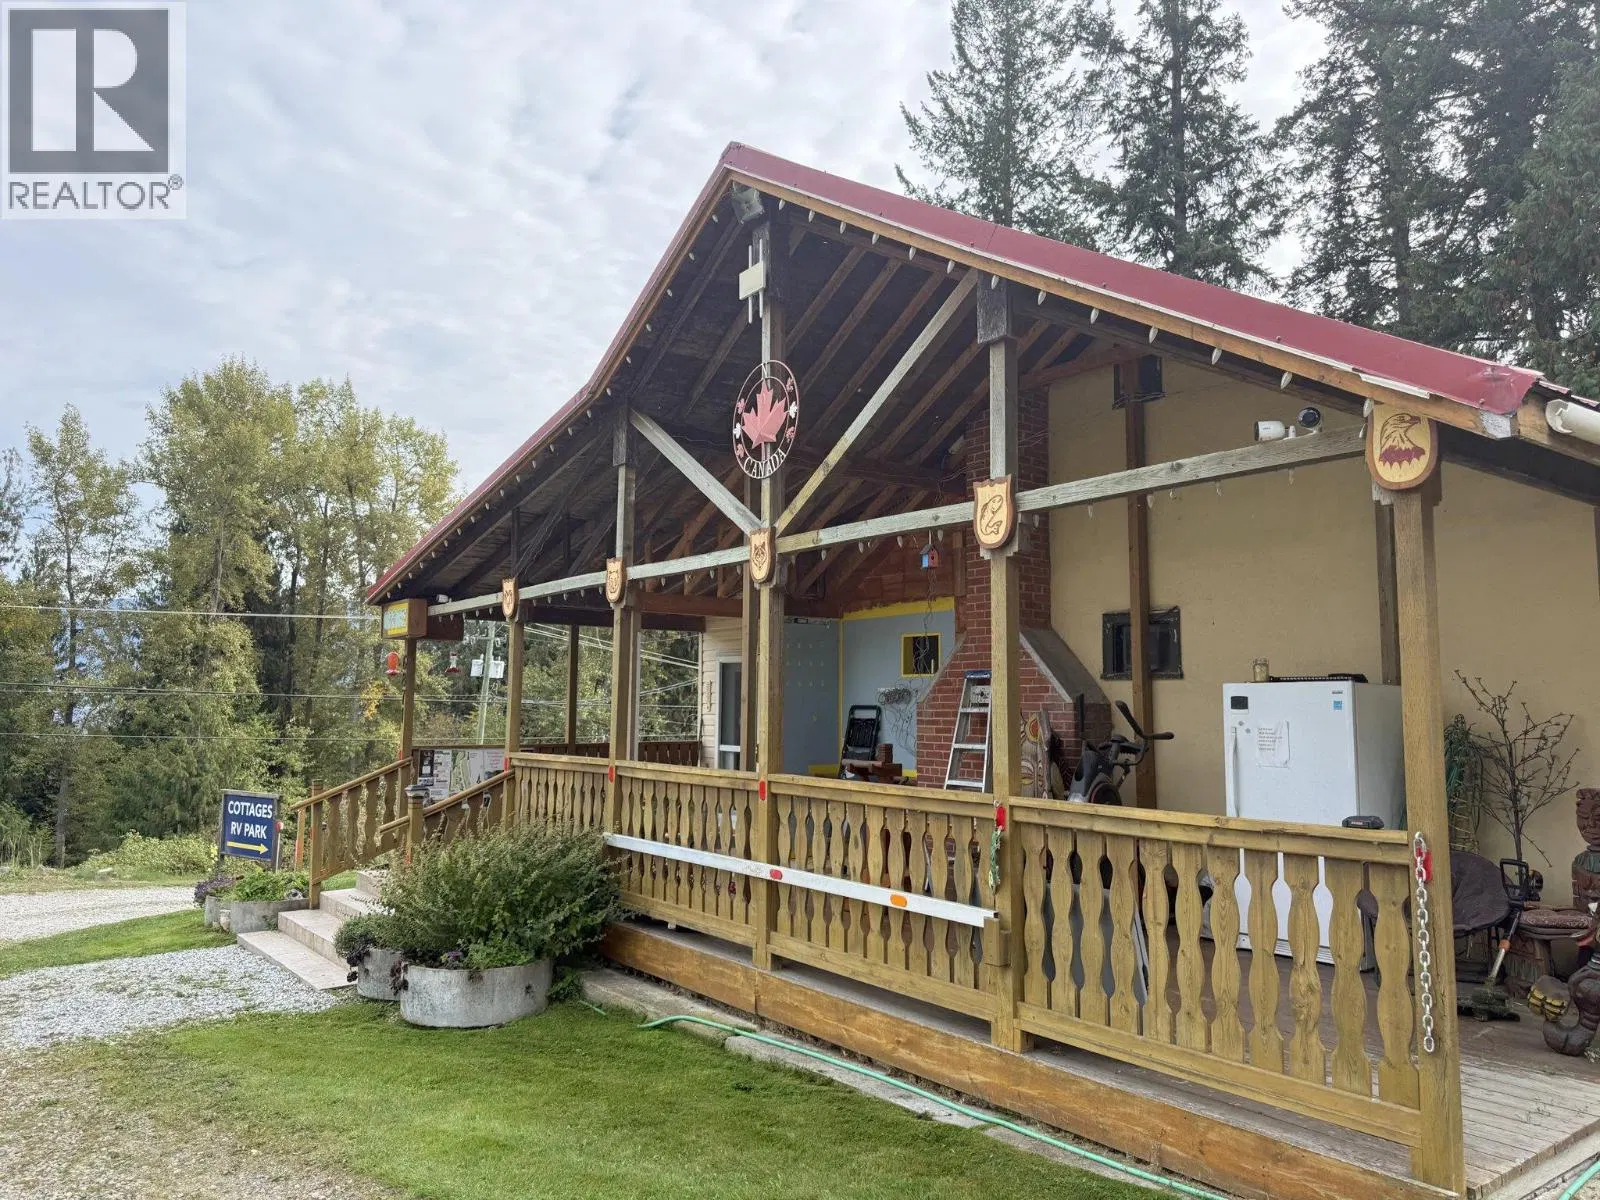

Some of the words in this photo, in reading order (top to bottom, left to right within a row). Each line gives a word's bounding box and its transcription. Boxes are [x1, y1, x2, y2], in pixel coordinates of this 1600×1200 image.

[743, 448, 786, 478] CANADA
[228, 801, 273, 818] COTTAGES
[231, 822, 242, 836] RV
[244, 823, 267, 839] PARK
